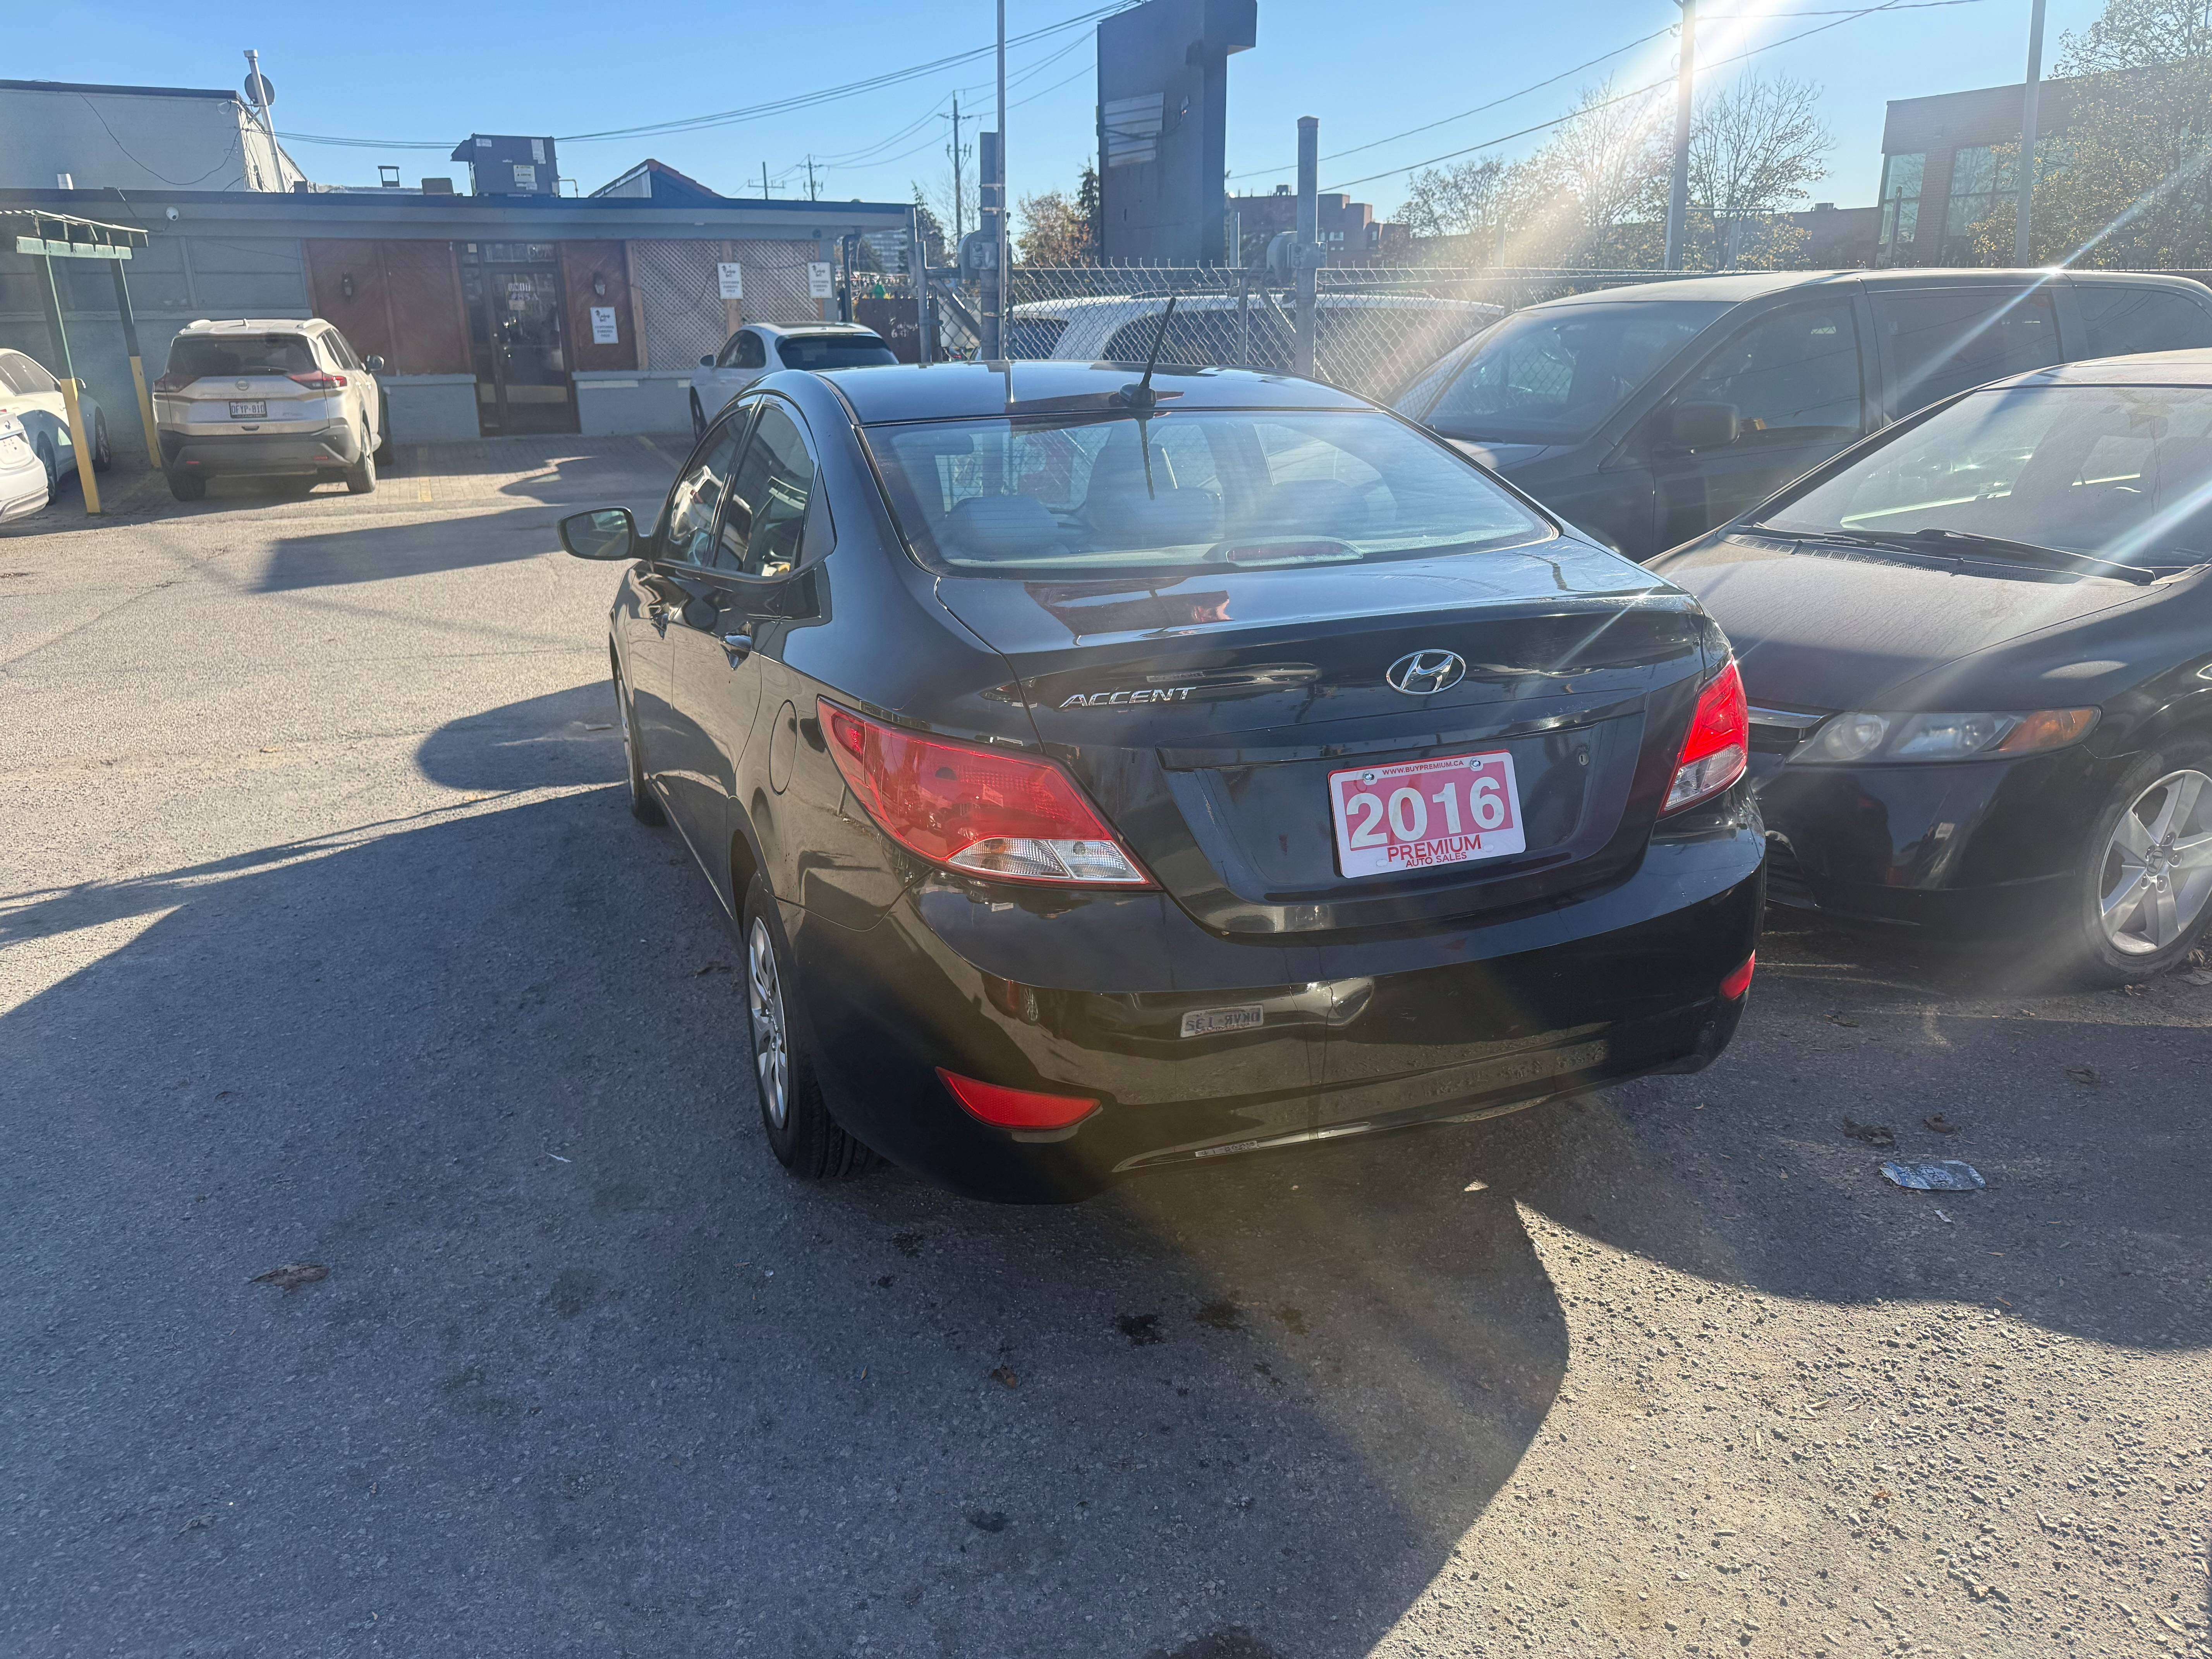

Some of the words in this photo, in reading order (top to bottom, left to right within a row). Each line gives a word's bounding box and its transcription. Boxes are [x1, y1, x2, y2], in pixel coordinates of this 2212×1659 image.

[1059, 687, 1197, 708] ACCENT
[1382, 760, 1464, 775] WWW.BUYPREMIUM.CA
[1346, 776, 1504, 848] 2016
[1387, 834, 1482, 862] PREMIUM
[1406, 857, 1433, 868] AUTO
[1436, 852, 1467, 863] SALES
